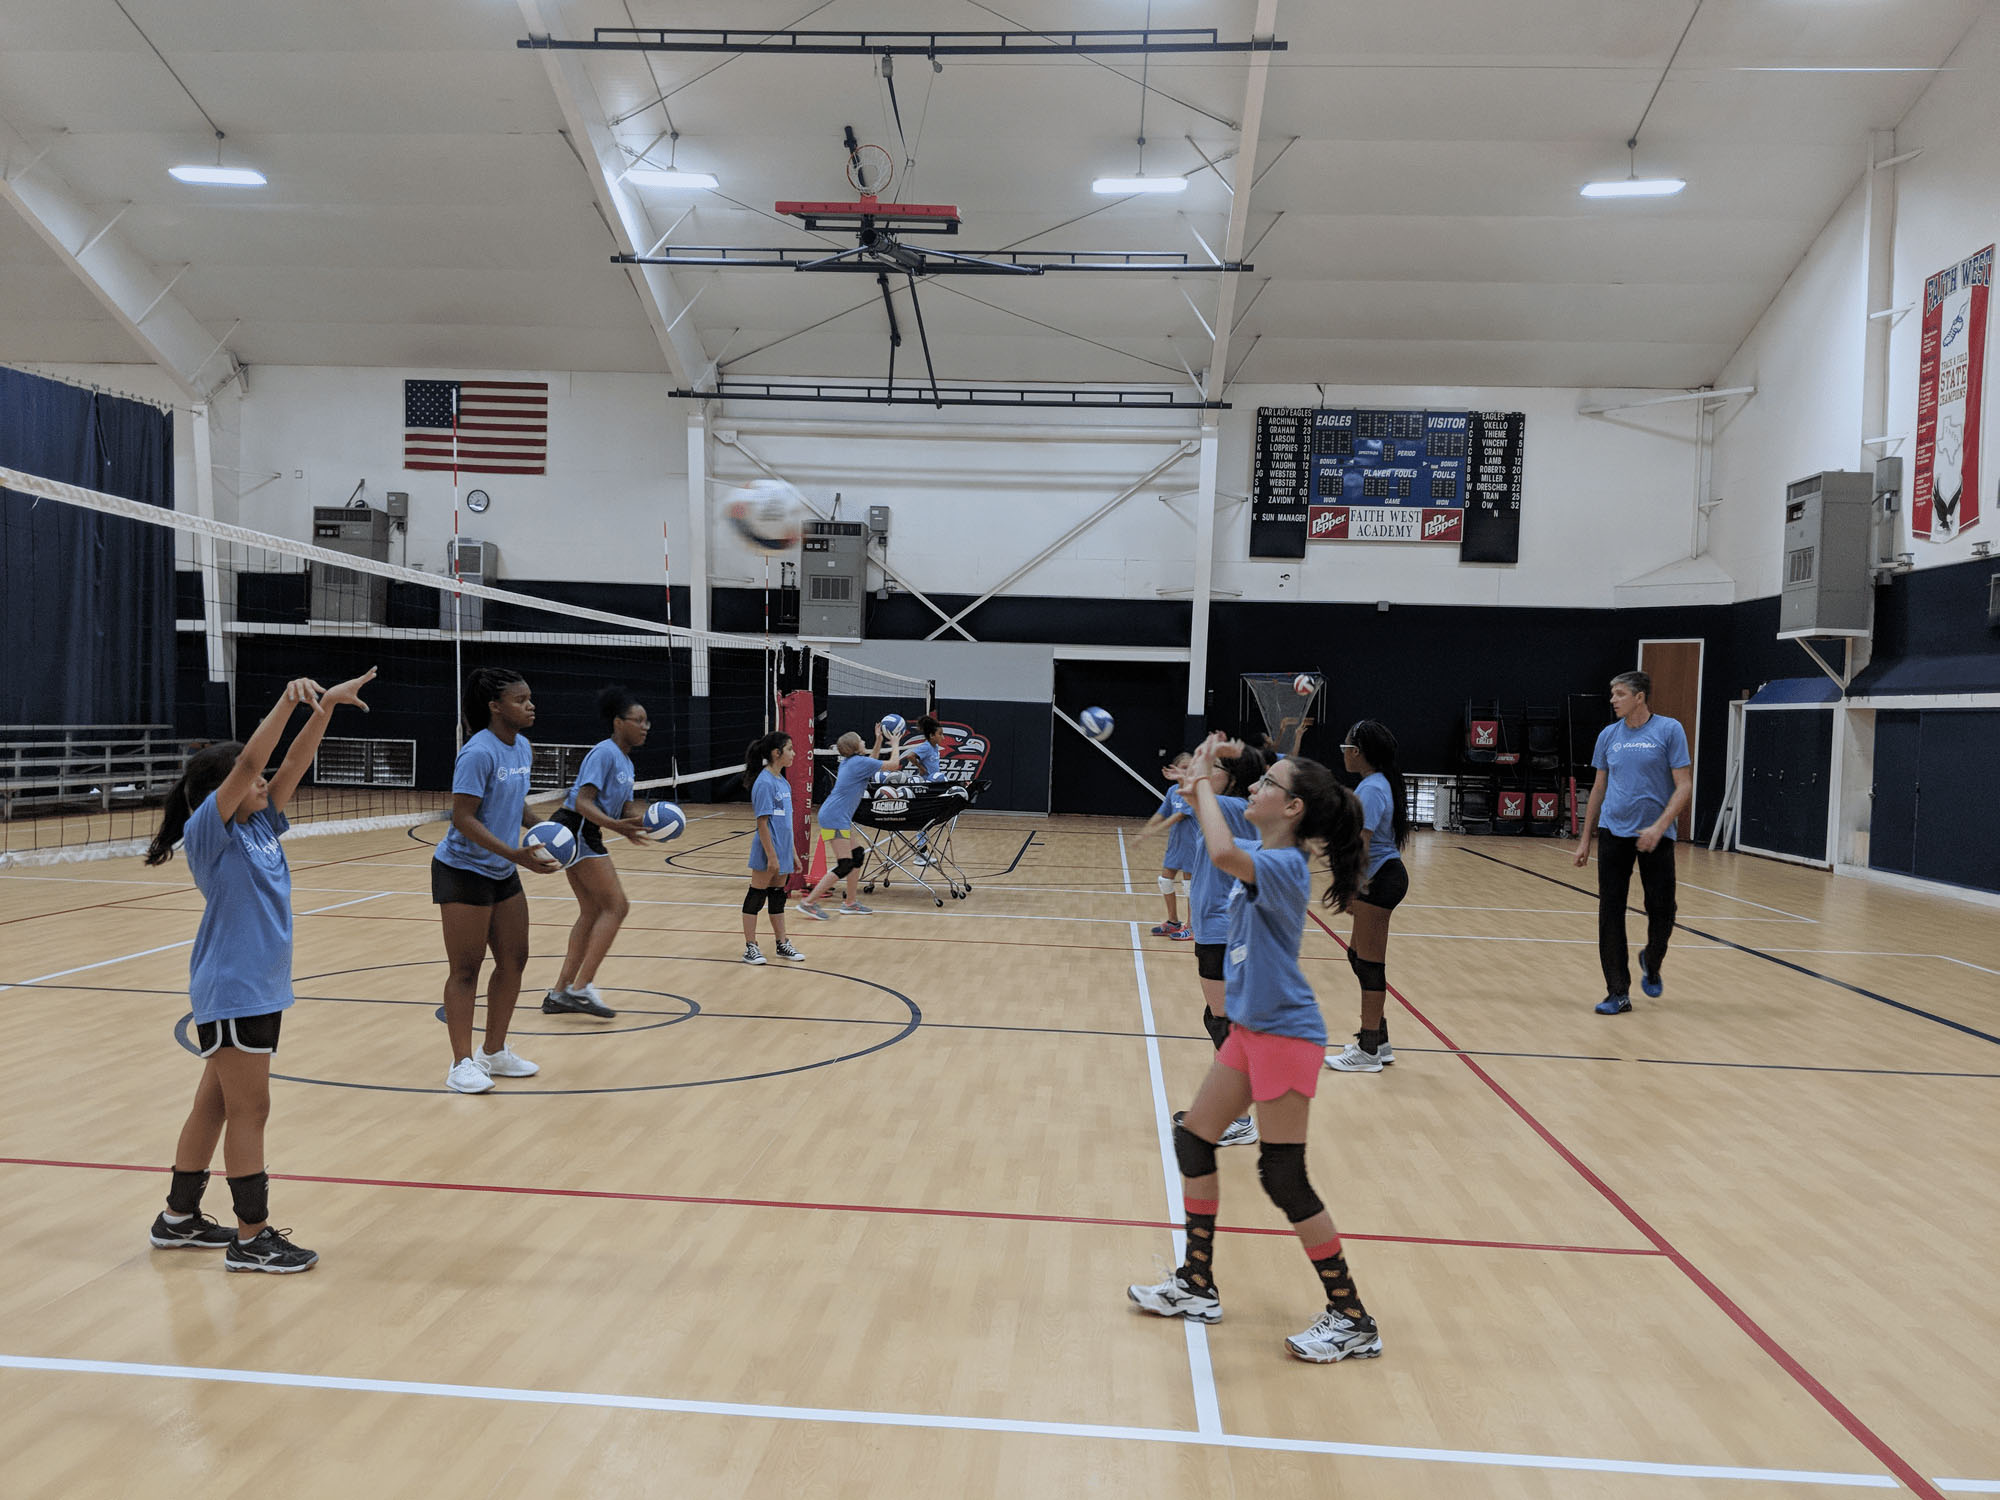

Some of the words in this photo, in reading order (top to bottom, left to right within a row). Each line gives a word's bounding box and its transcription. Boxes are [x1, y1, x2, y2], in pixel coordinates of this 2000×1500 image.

[1926, 266, 1957, 317] FAITH
[1961, 248, 1993, 289] WEST
[1940, 364, 1967, 392] STATE
[1268, 417, 1298, 425] ARCHINAL
[1303, 418, 1312, 426] 24
[1316, 415, 1352, 426] EAGLES
[1428, 417, 1466, 428] VISITOR
[1269, 426, 1295, 434] GRAHAM
[1519, 422, 1524, 430] 2
[1481, 439, 1508, 447] VINCENT
[1483, 448, 1503, 456] CRAIN
[1516, 448, 1522, 456] 11
[1303, 453, 1310, 461] 14
[1484, 457, 1502, 465] LAMB
[1271, 461, 1296, 469] VAUGHN
[1302, 462, 1309, 470] 12
[1479, 465, 1506, 474] ROBERTS
[1512, 466, 1521, 474] 20
[1269, 470, 1297, 478] WEBSTER
[1363, 469, 1391, 477] PLAYER
[1394, 470, 1418, 478] FOULS
[1432, 471, 1456, 479] FOULS
[1480, 474, 1503, 482] MILLER
[1513, 475, 1521, 483] 21
[1476, 483, 1508, 491] DRESCHER
[1299, 488, 1308, 496] 00
[1482, 492, 1499, 500] TRAN
[1268, 496, 1295, 504] ZAVIDNY
[1510, 501, 1519, 509] 32
[1252, 513, 1258, 521] K
[1261, 513, 1275, 521] SUN
[1277, 513, 1307, 522] MANAGER
[1321, 511, 1334, 523] Dr
[1350, 510, 1384, 522] FAITH
[1390, 510, 1421, 523] WEST
[1493, 509, 1499, 518] N
[1312, 513, 1346, 535] Pepper
[1433, 514, 1446, 526] Dr
[1357, 524, 1413, 537] ACADEMY
[1424, 516, 1459, 537] Pepper
[872, 801, 907, 811] TACHIKARA
